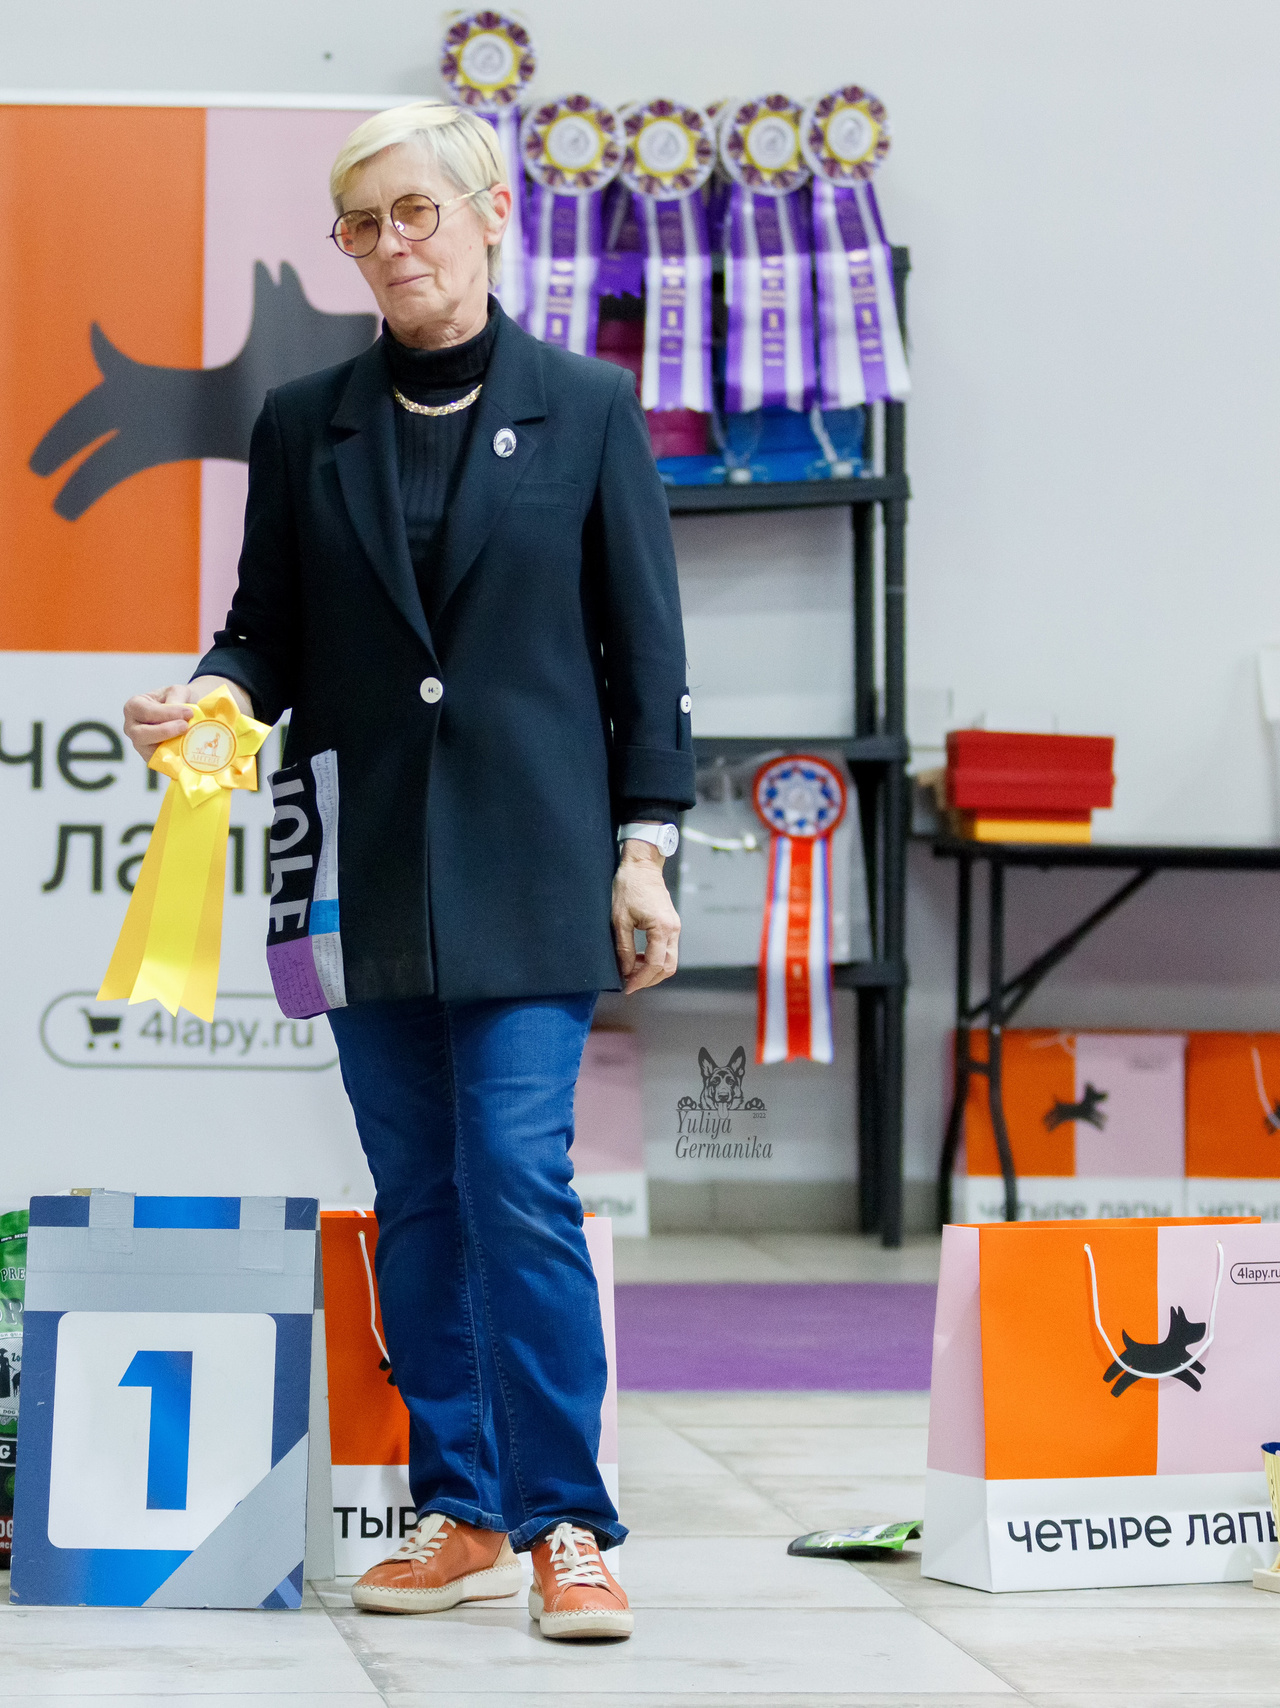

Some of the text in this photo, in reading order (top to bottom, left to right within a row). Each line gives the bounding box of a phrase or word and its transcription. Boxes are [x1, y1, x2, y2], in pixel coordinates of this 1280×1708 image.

[139, 1010, 315, 1056] 4lapy.ru
[117, 1350, 193, 1510] 1
[1007, 1514, 1172, 1553] четыре
